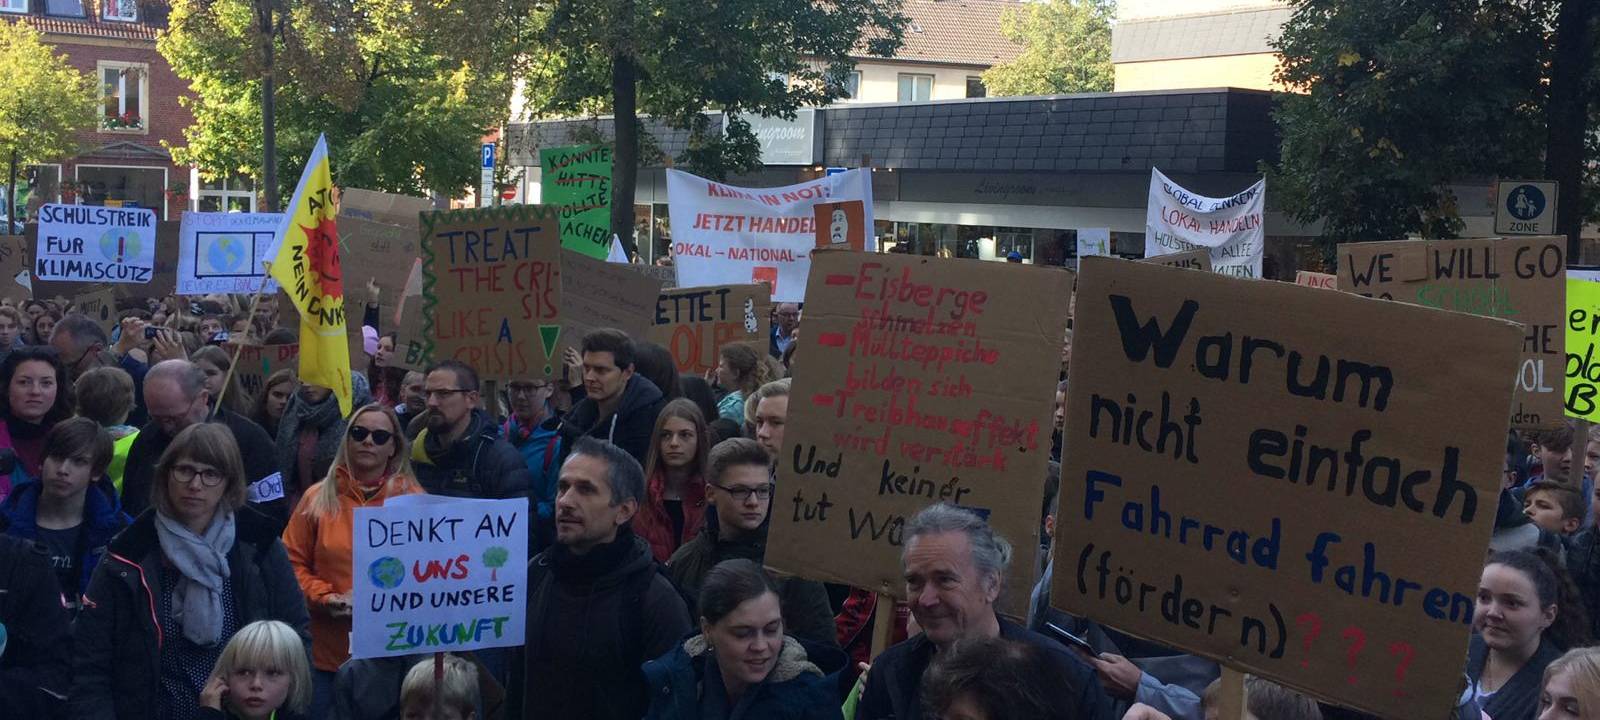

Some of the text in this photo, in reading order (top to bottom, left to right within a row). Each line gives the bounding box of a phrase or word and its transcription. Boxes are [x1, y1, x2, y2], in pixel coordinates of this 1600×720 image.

[484, 147, 491, 165] P
[40, 204, 152, 228] SCHULSTREIK
[562, 193, 609, 219] OLLTE
[758, 192, 782, 206] IN
[562, 222, 611, 248] ACHEN
[692, 213, 817, 234] JETZT HANDEL
[1161, 206, 1262, 236] LOKAL HANDELN
[1509, 221, 1540, 233] ZONE
[436, 226, 541, 264] TREAT
[674, 242, 795, 263] OKAL NATIONAL
[1220, 242, 1252, 258] ALLEE
[37, 258, 153, 283] KLIMASCUTZ
[290, 244, 308, 303] NEIN
[448, 263, 507, 293] THE
[1348, 243, 1563, 288] WE WILL GO
[521, 287, 558, 321] SIS
[651, 288, 731, 327] ETTET
[854, 262, 988, 320] Eisberge
[434, 307, 513, 344] LIKE A
[856, 302, 977, 338] schmelzen
[1109, 293, 1395, 413] Warum
[1522, 324, 1558, 353] HE
[844, 363, 974, 400] bilden sich
[1514, 358, 1554, 393] OL
[832, 425, 891, 456] wird
[1088, 390, 1479, 525] nicht einfach
[792, 443, 972, 504] Und keiner
[792, 488, 834, 522] tut
[368, 511, 518, 548] DENKT AN
[1084, 469, 1476, 626] Fahrrad fahren
[412, 553, 470, 584] UNS
[370, 584, 515, 613] UND UNSERE
[385, 615, 510, 651] ZUKUNFT
